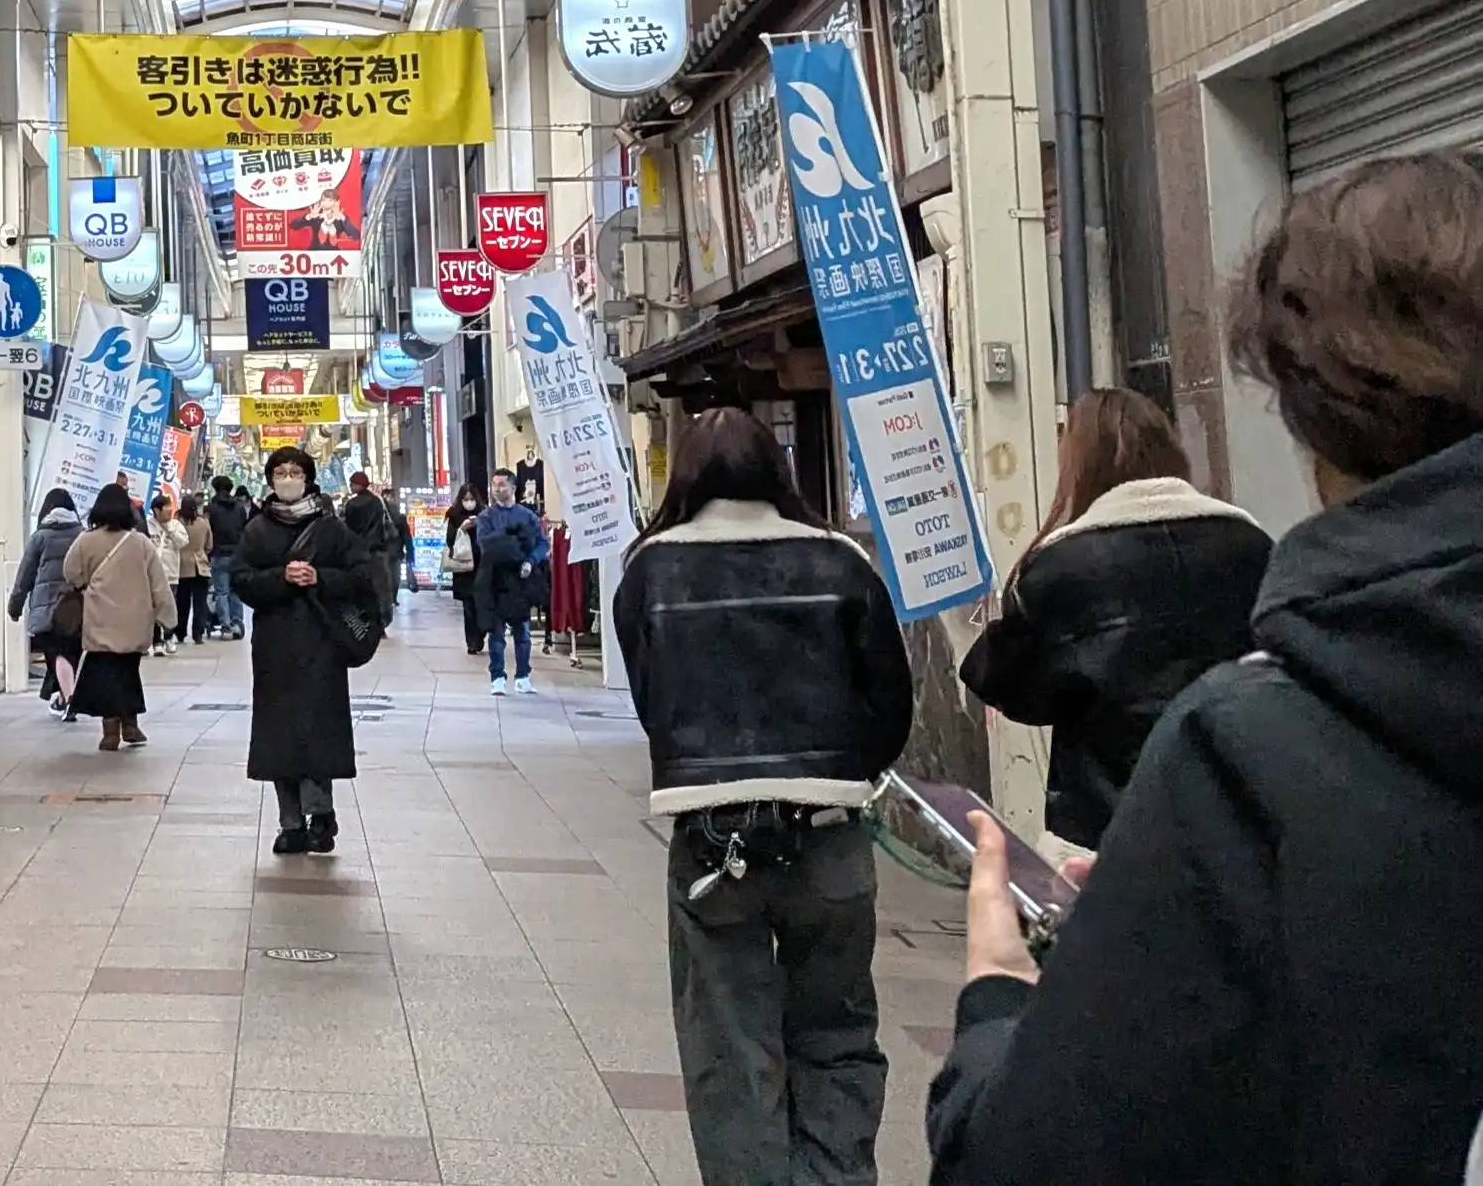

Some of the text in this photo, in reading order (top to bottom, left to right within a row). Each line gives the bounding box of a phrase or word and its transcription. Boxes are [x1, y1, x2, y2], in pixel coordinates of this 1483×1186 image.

[585, 22, 669, 59] 武蔵
[136, 53, 422, 87] 客引きは迷惑行為!!
[147, 89, 413, 120] ついていかないで
[238, 148, 347, 177] 高価買取
[84, 212, 129, 236] QB
[86, 237, 126, 248] HOUSE
[247, 253, 329, 276] この先 30m
[264, 278, 309, 302] QB
[268, 303, 306, 313] HOUSE
[72, 364, 131, 400] 北九州
